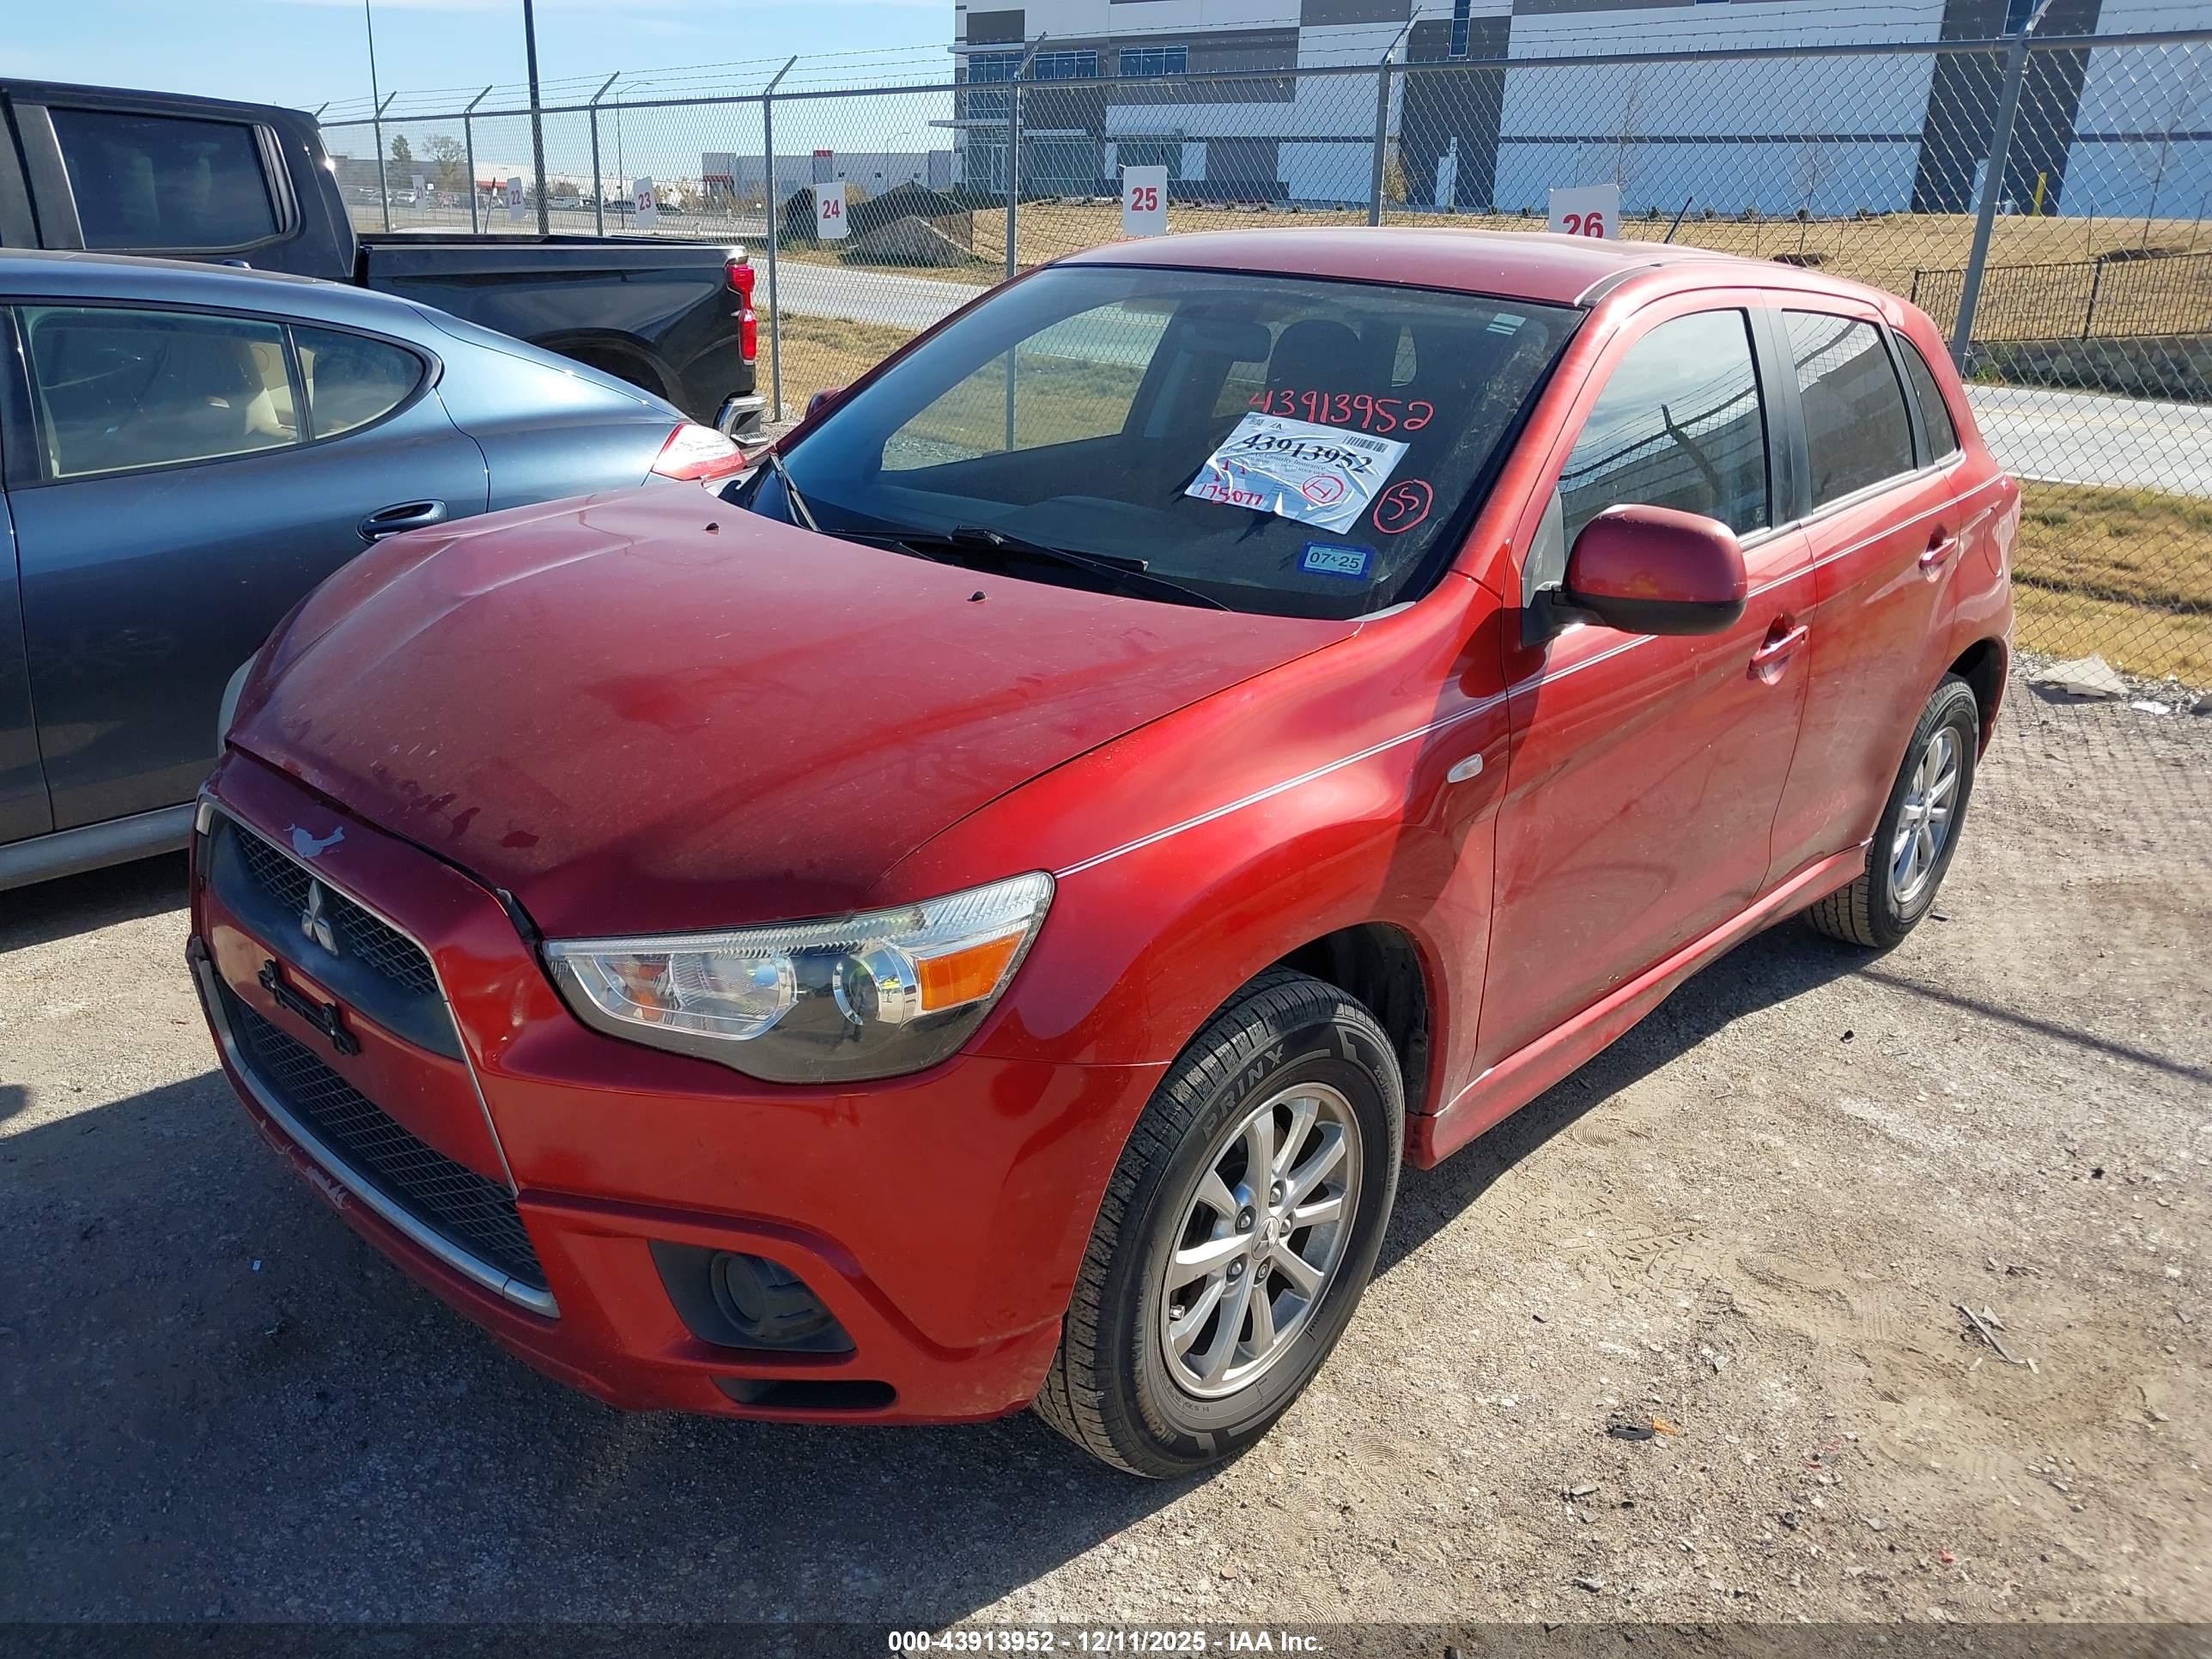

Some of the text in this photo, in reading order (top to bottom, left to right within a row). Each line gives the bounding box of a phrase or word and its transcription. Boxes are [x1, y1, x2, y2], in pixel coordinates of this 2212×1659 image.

[415, 185, 425, 200] 21
[511, 190, 521, 205] 22
[638, 191, 652, 211] 23
[1131, 186, 1158, 212] 25
[822, 198, 841, 220] 24
[1562, 211, 1604, 239] 26
[1249, 390, 1435, 433] 43913952
[1242, 433, 1374, 474] 43913952
[1202, 1043, 1285, 1141] PRINX
